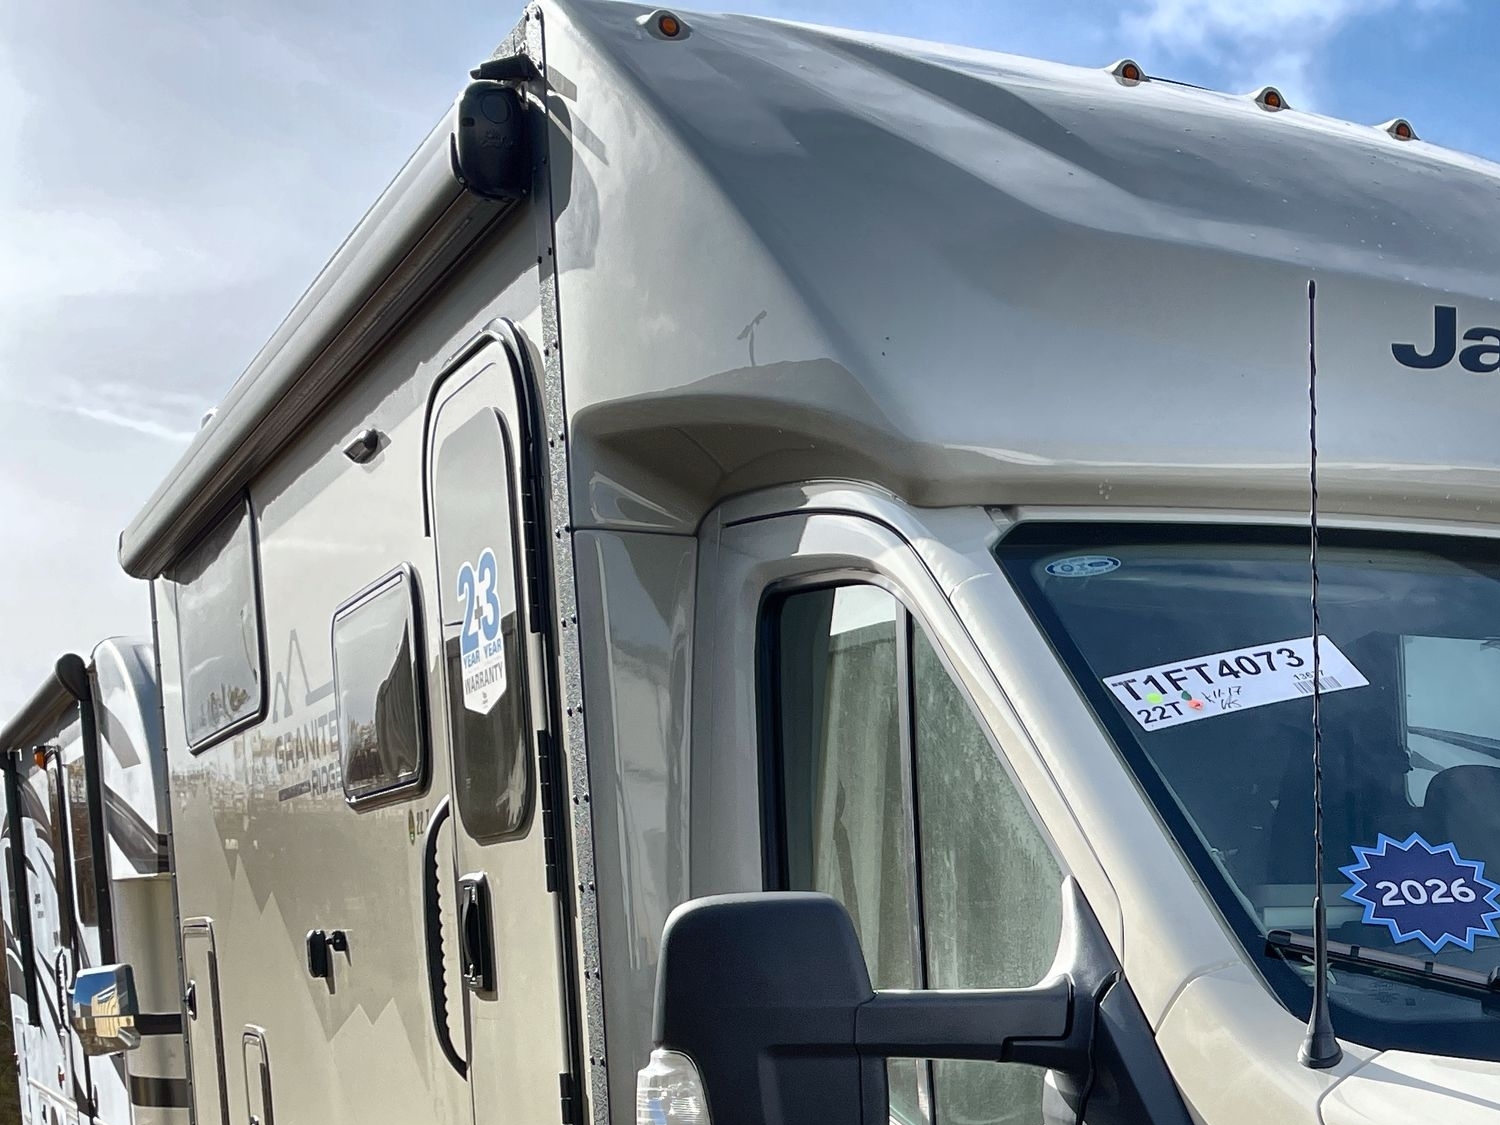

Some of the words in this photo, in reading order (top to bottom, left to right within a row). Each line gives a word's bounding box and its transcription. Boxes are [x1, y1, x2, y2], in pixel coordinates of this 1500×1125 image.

[463, 650, 480, 669] YEAR
[483, 637, 502, 659] YEAR
[464, 660, 503, 696] WARRANTY
[1111, 648, 1305, 701] T1FT4073
[1293, 669, 1324, 681] 1367
[1137, 701, 1185, 725] 22T
[275, 710, 339, 775] GRANITE
[312, 760, 343, 798] RIDGE
[1375, 878, 1476, 907] 2026
